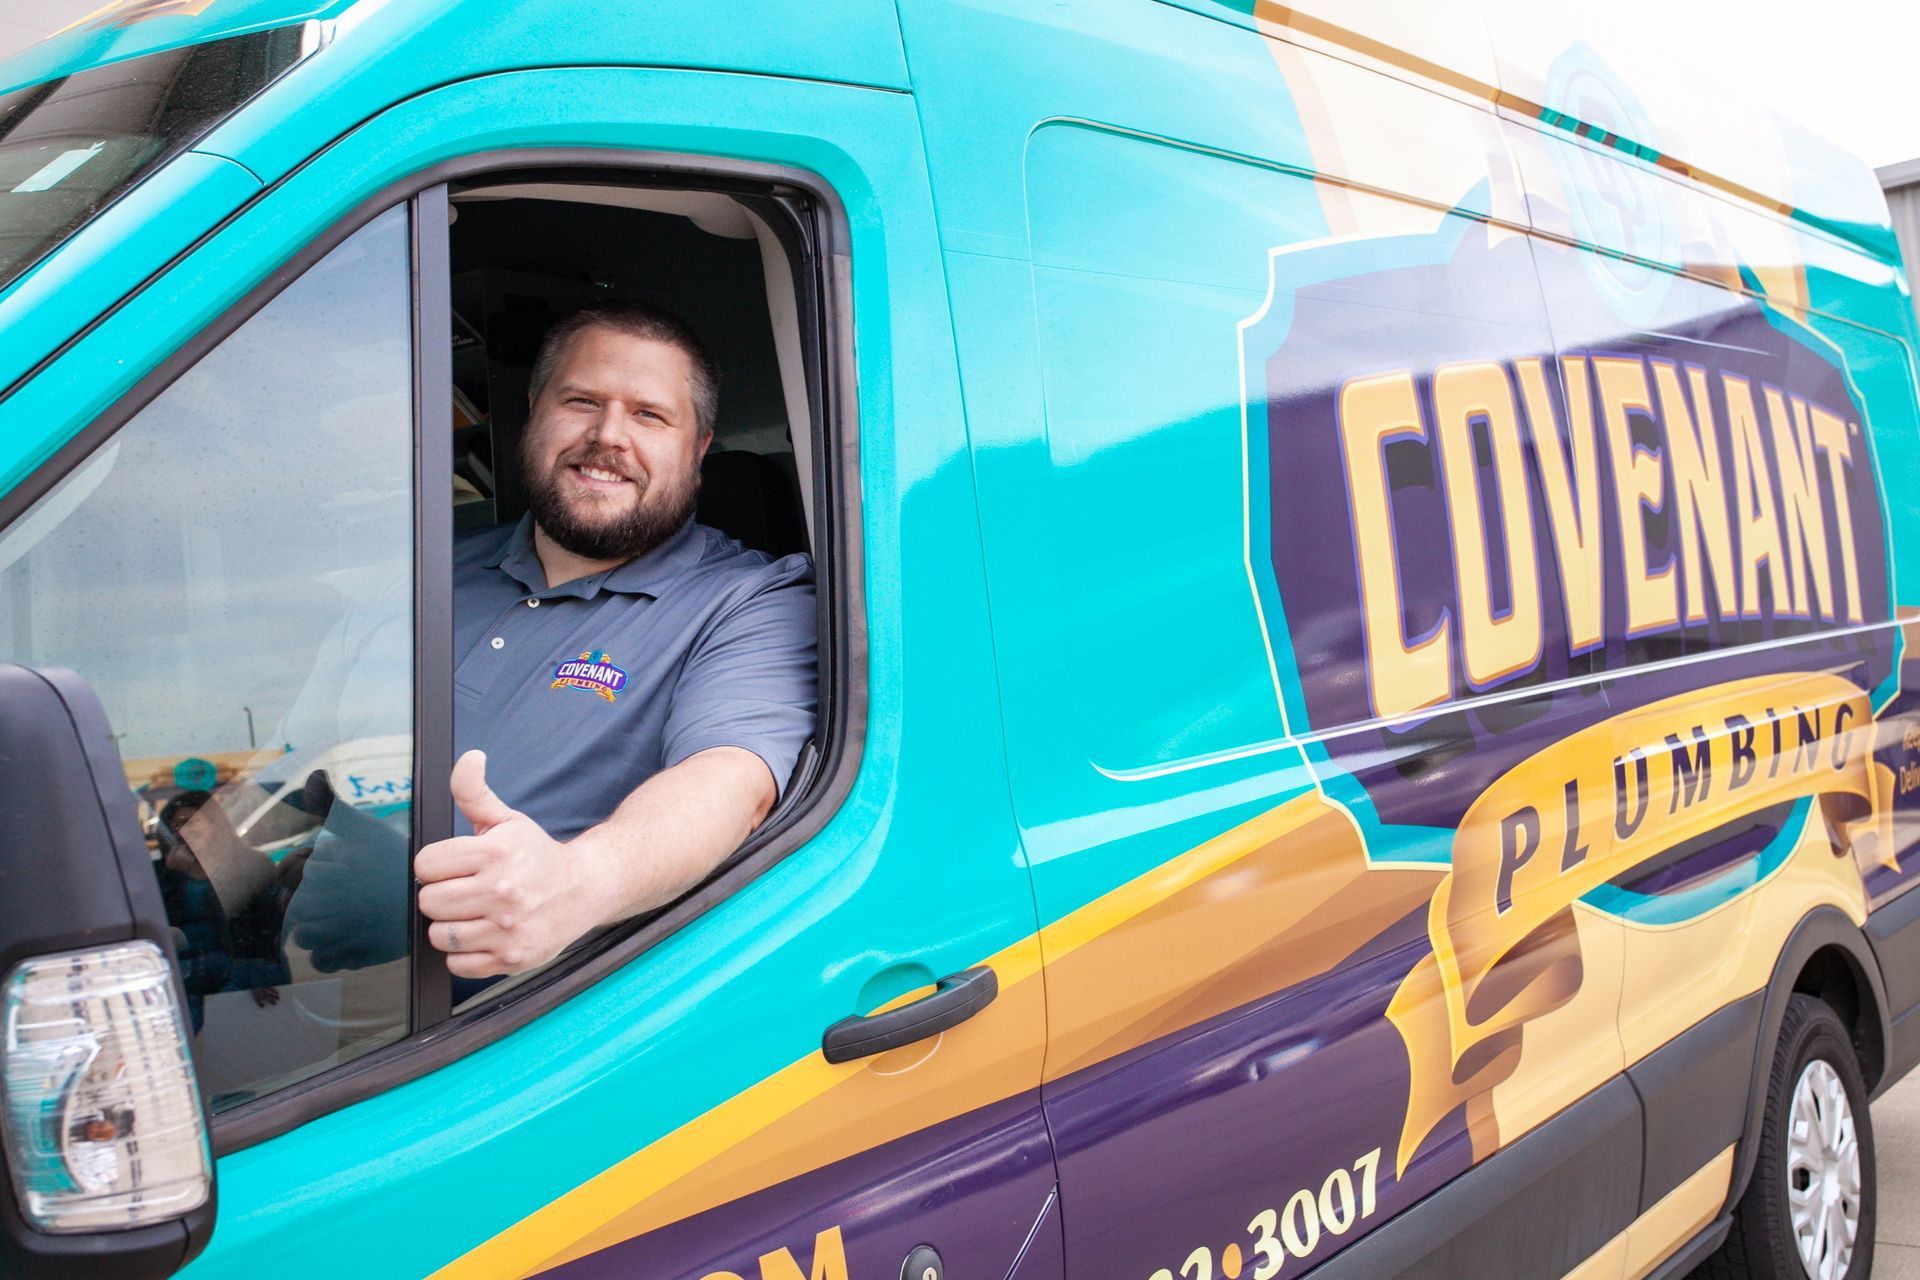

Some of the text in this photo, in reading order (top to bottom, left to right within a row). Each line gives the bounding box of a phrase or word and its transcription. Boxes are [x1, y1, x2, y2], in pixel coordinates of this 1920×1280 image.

[1338, 354, 1864, 727] COVENANT
[558, 662, 623, 687] COVENANT
[1495, 702, 1855, 916] PLUMBING
